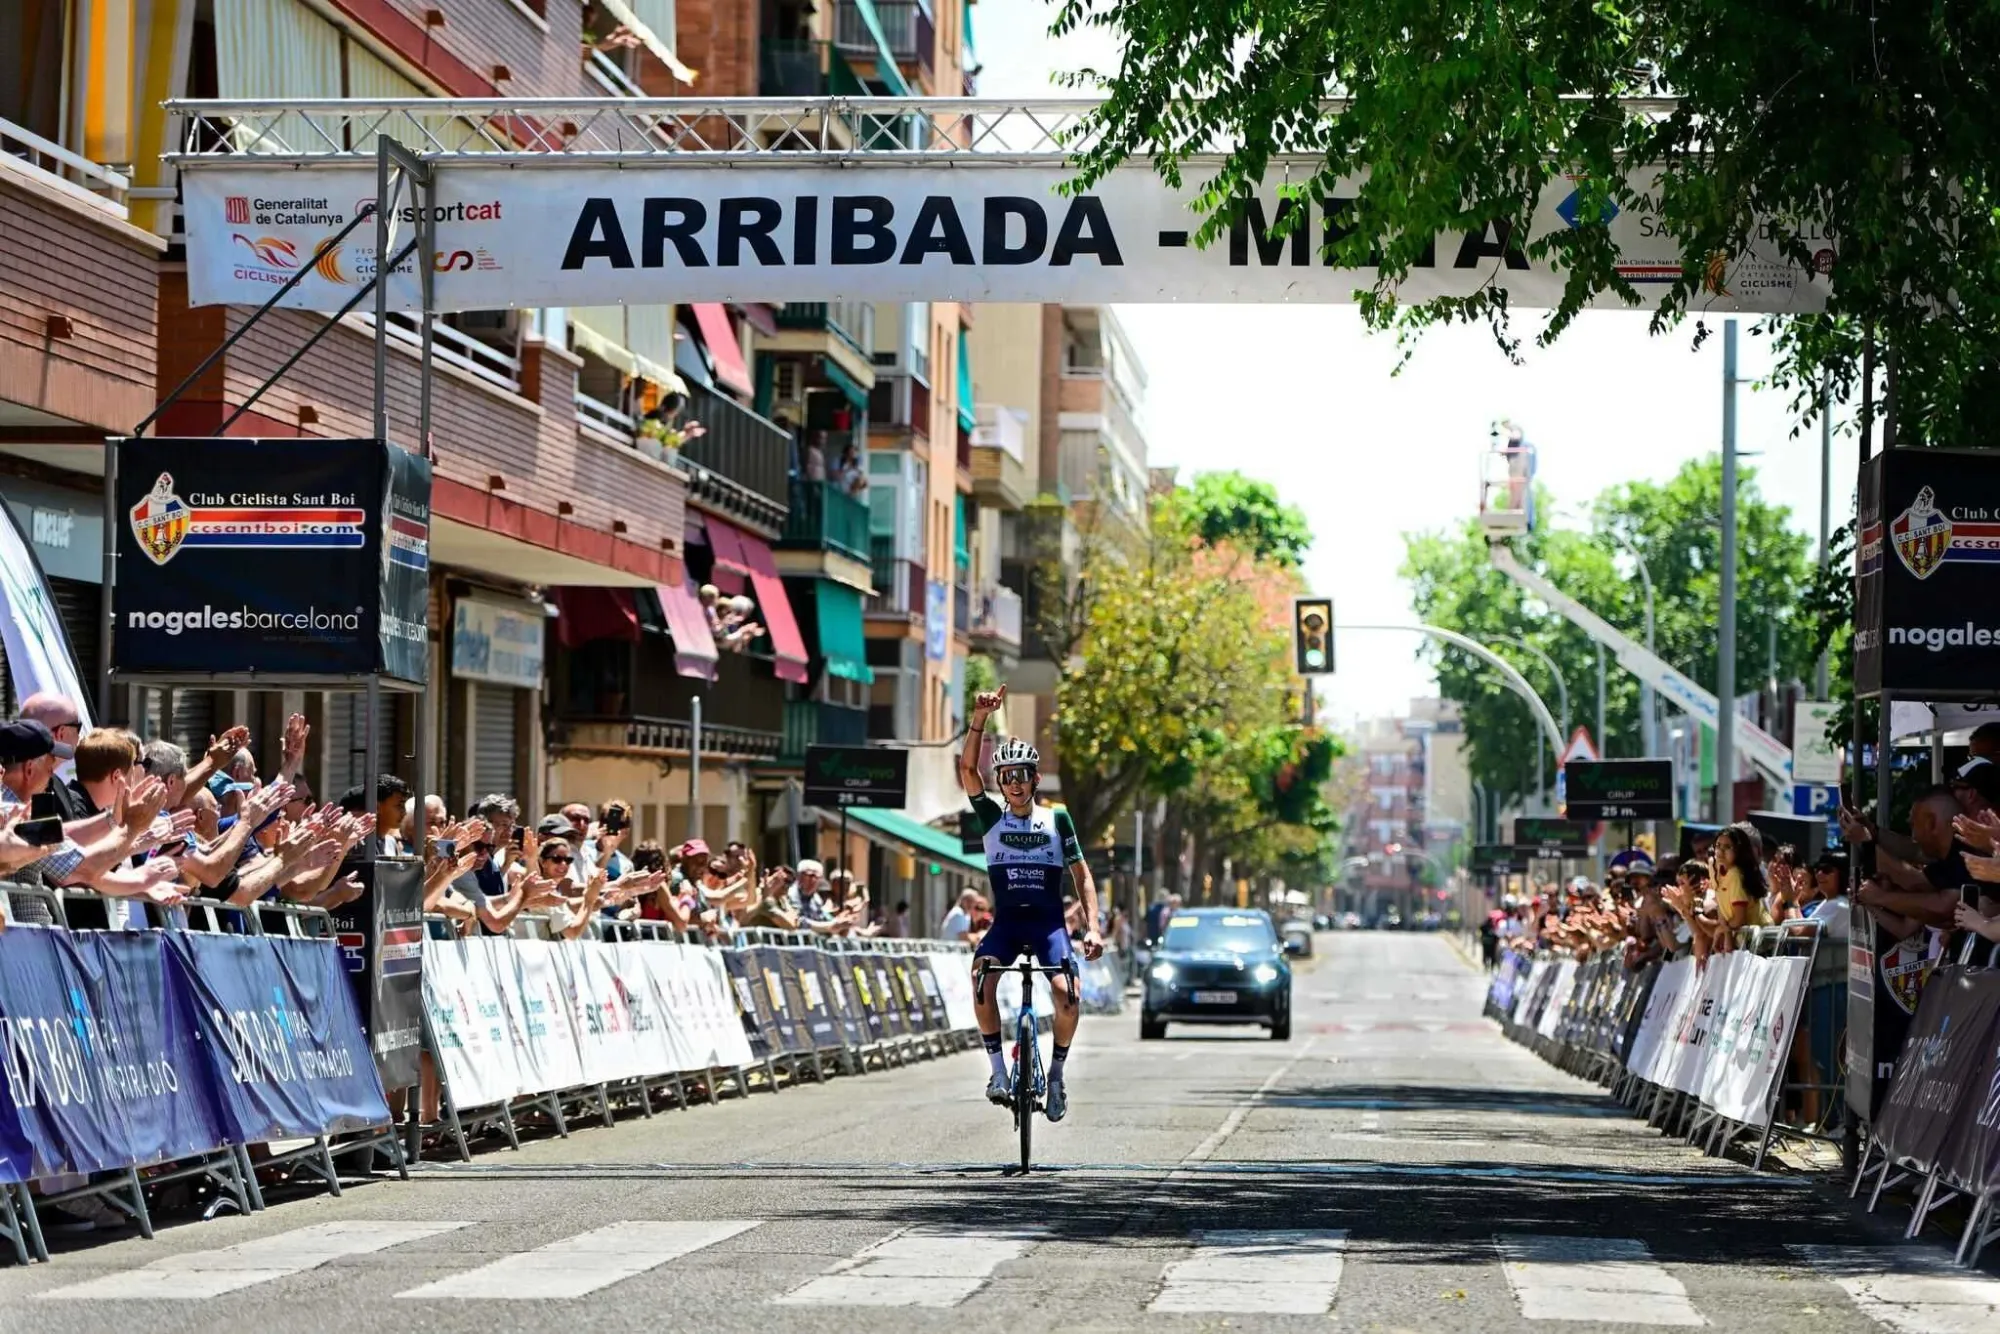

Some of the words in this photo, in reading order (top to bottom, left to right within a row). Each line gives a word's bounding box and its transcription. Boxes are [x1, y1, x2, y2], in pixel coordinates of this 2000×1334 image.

[253, 197, 329, 211] Generalitat
[256, 213, 271, 225] de
[275, 213, 343, 227] Catalunya
[561, 195, 1125, 271] ARRIBADA
[1740, 280, 1792, 288] CICLISME
[189, 492, 225, 506] Club
[230, 492, 288, 506] Ciclista
[292, 492, 325, 506] Sant
[331, 492, 356, 506] Boi
[153, 513, 171, 525] SANT
[172, 511, 184, 521] BOI
[1951, 506, 1988, 520] Club
[190, 522, 354, 534] ccsantboi.com
[1913, 527, 1932, 538] SANT
[1933, 524, 1946, 533] BOI
[128, 604, 359, 636] nogalesbarcelona
[1889, 621, 2000, 652] nogales
[1809, 787, 1829, 812] P
[1601, 805, 1618, 817] 25
[1621, 807, 1637, 817] m.
[1903, 961, 1922, 973] SANT
